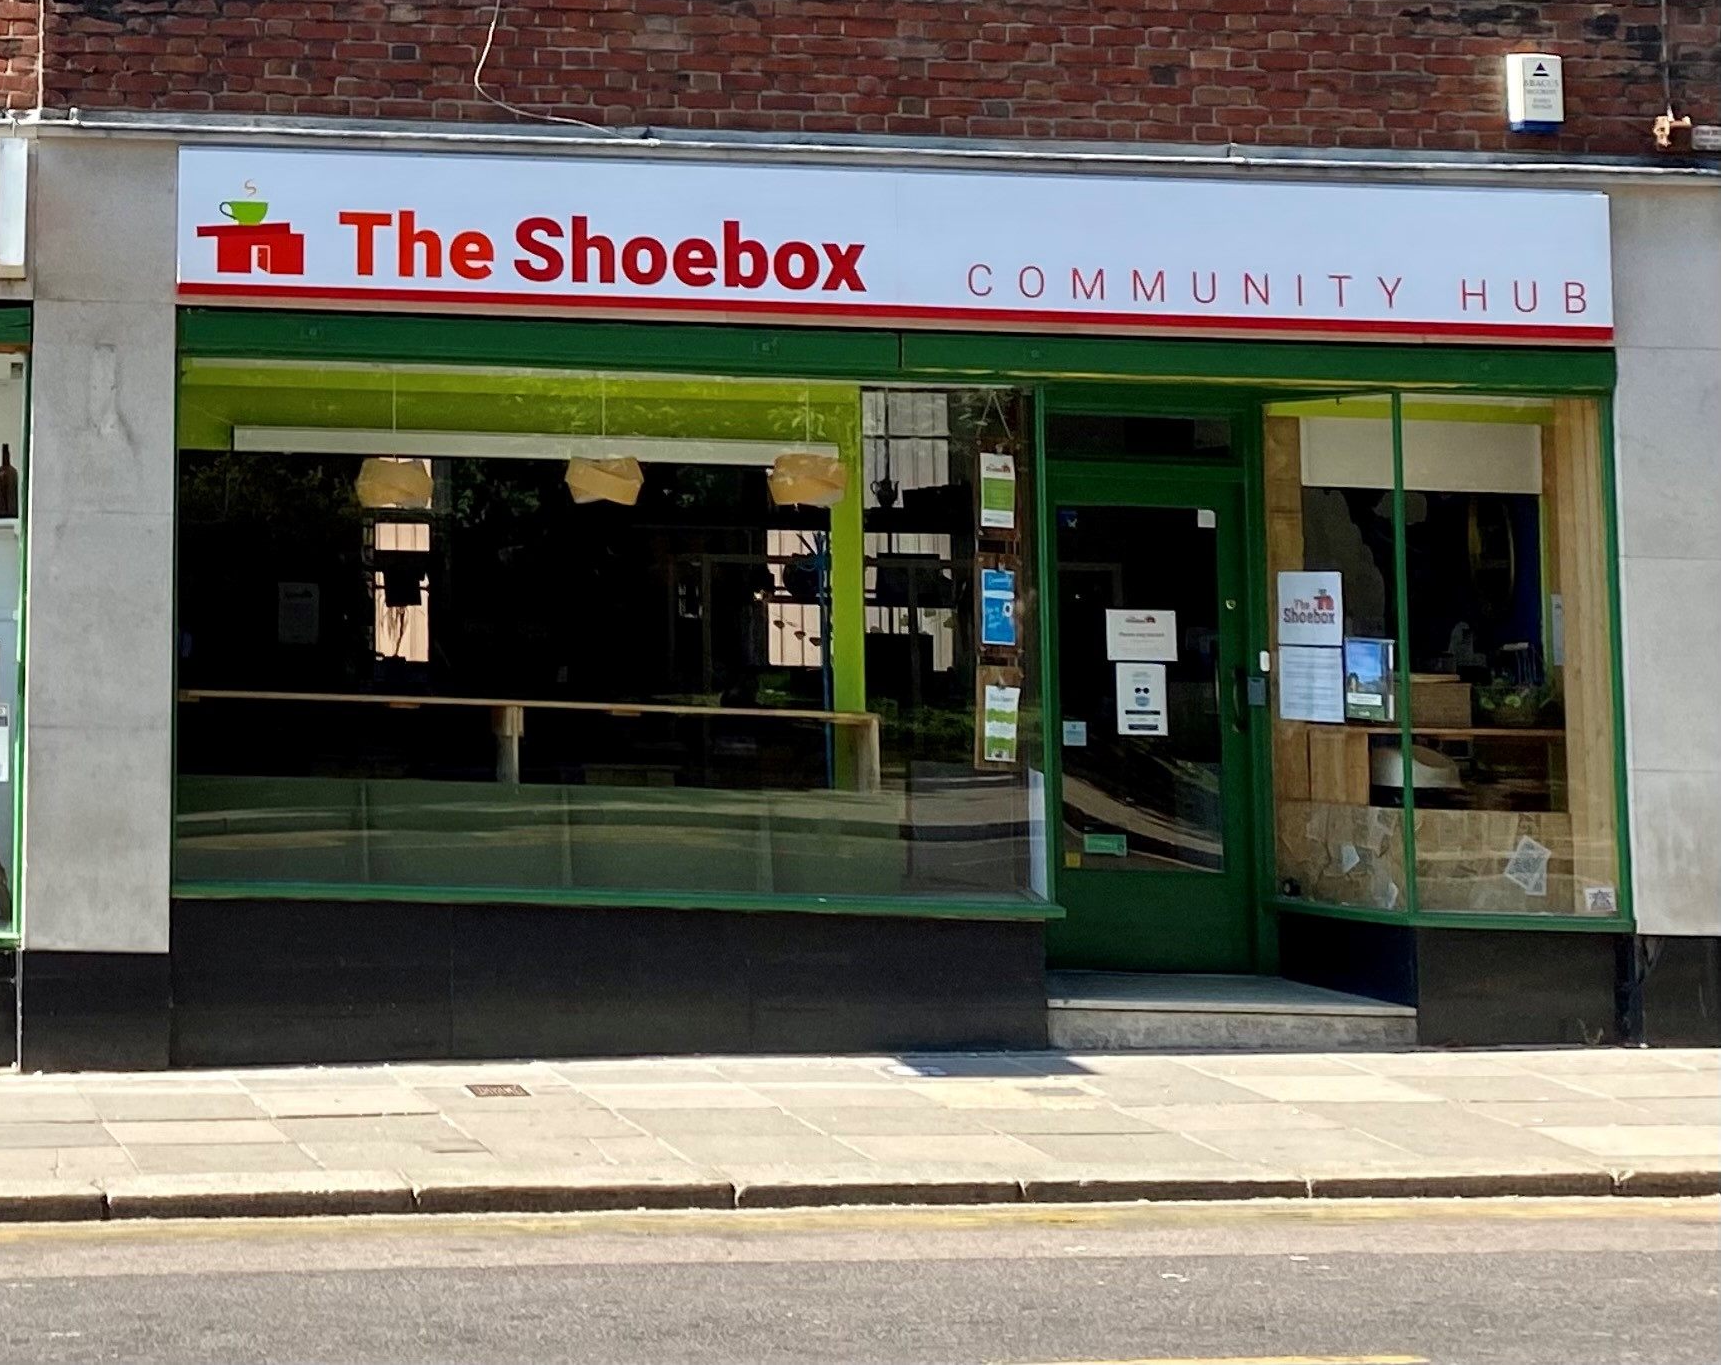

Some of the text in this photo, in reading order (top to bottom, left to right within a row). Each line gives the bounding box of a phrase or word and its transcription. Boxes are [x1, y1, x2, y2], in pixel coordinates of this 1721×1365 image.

[339, 210, 868, 294] The Shoebox
[967, 263, 1589, 315] COMMUNITY HUB
[1283, 607, 1335, 624] Shoebox
[1293, 598, 1310, 609] The
